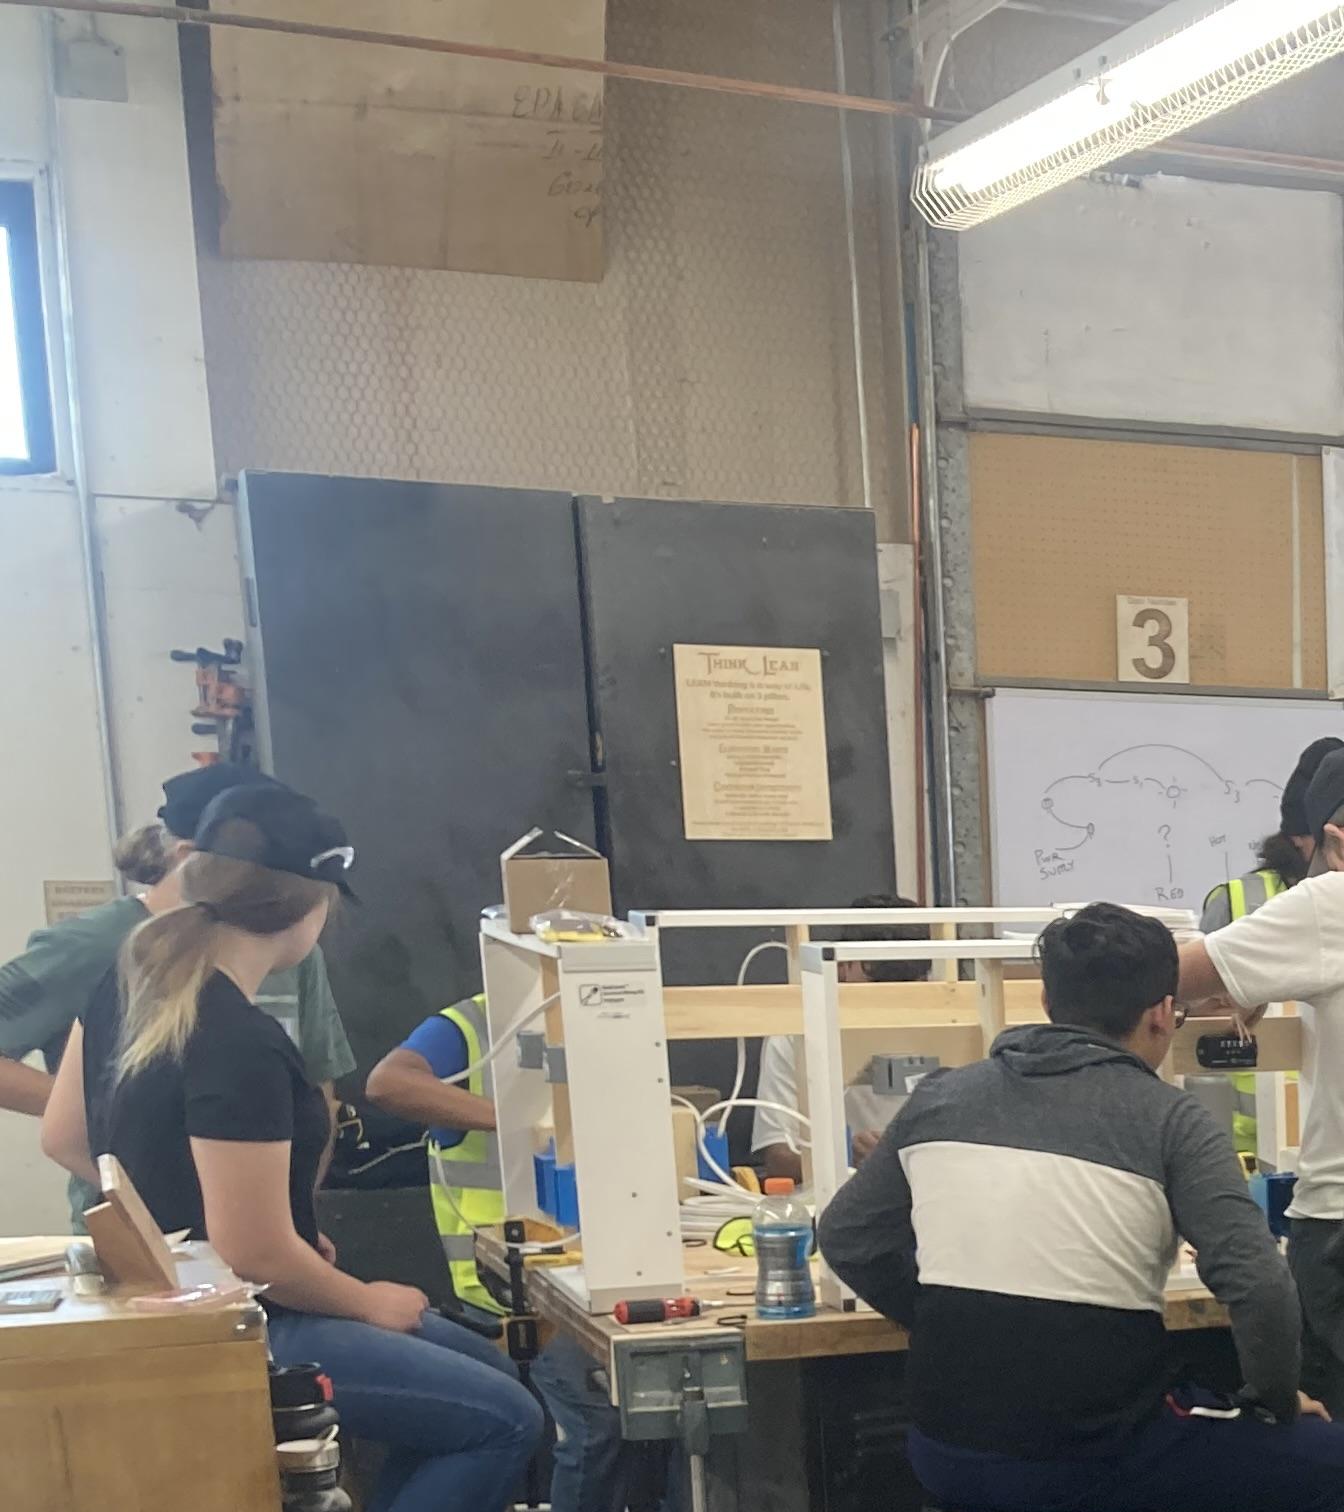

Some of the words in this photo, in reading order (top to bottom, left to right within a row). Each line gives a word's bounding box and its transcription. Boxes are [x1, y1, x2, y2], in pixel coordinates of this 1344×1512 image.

[1132, 608, 1176, 680] 3
[697, 652, 761, 676] THINK
[763, 655, 800, 677] LEAN
[1155, 887, 1185, 901] RED
